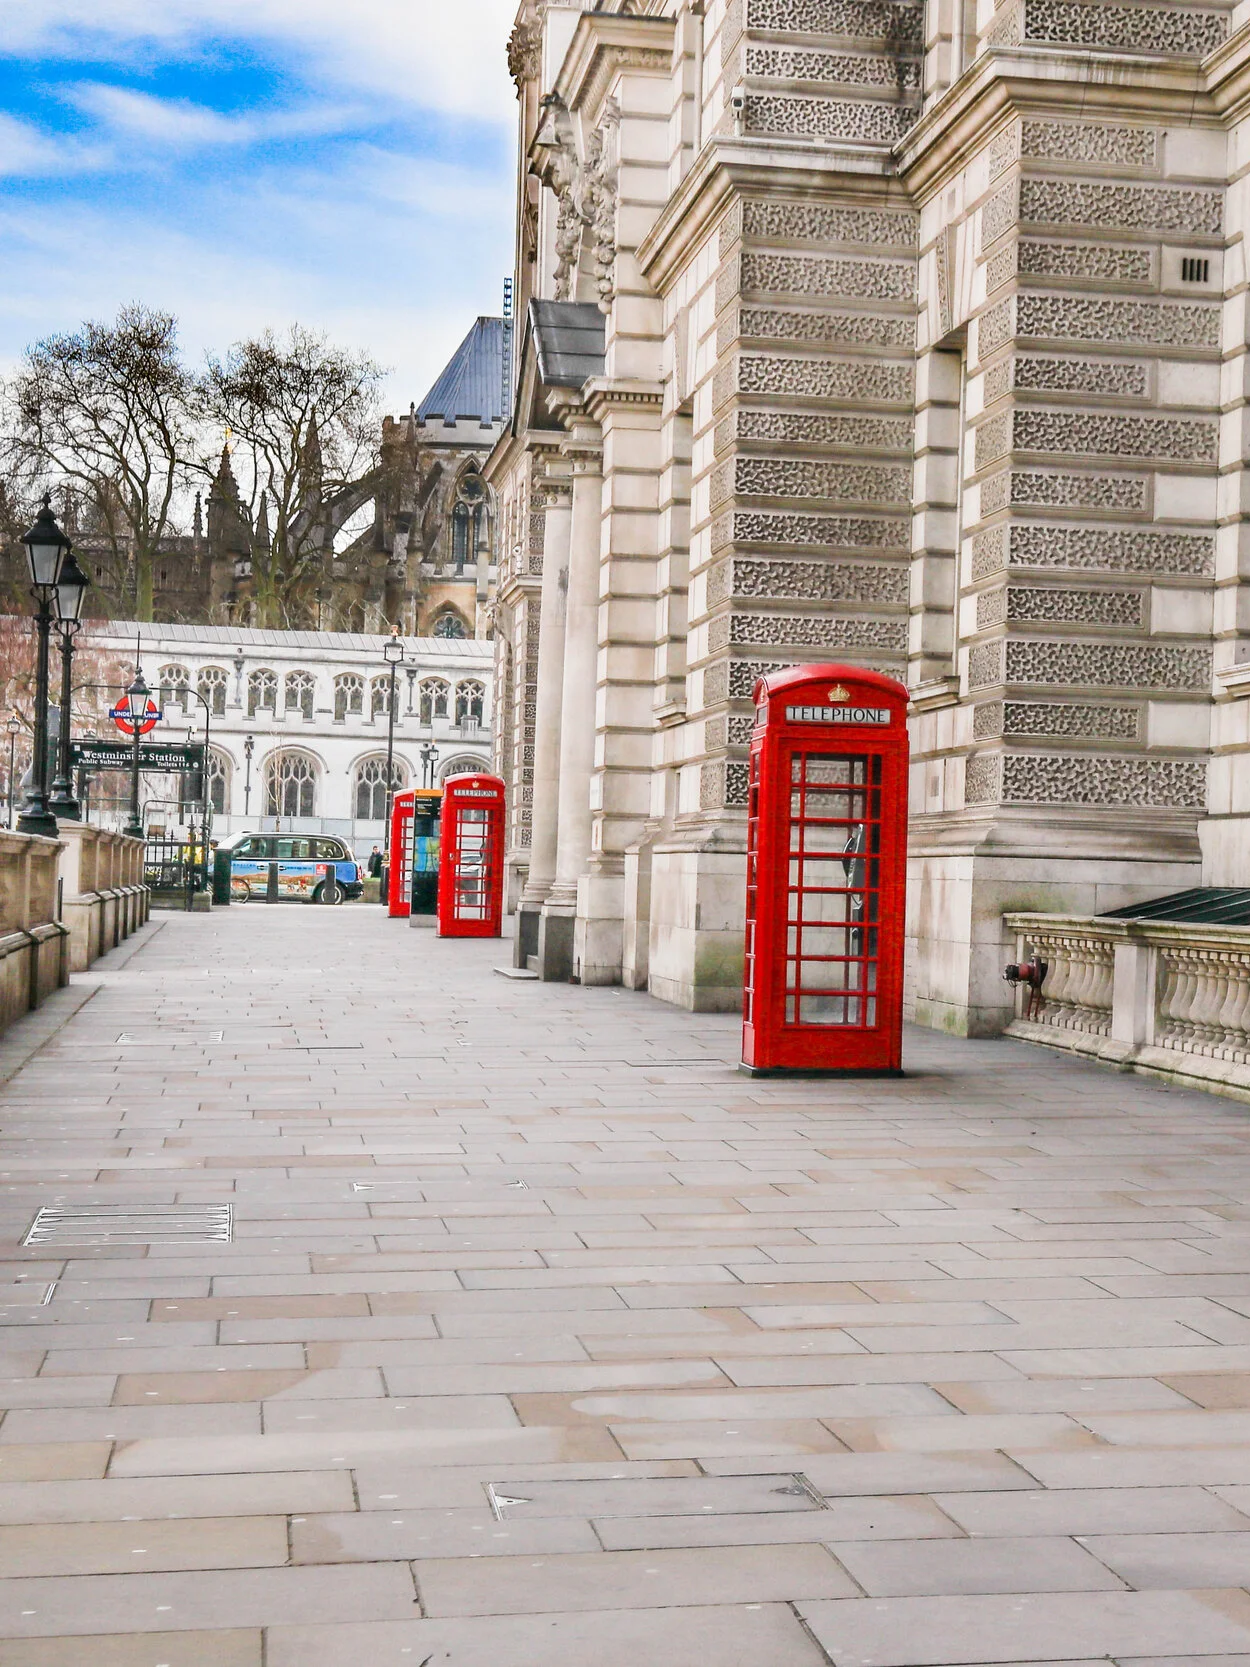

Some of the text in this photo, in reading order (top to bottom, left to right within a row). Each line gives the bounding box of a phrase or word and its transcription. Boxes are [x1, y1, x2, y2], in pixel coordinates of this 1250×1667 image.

[789, 706, 886, 723] TELEPHONE
[149, 753, 185, 762] Station
[100, 759, 124, 767] Subway
